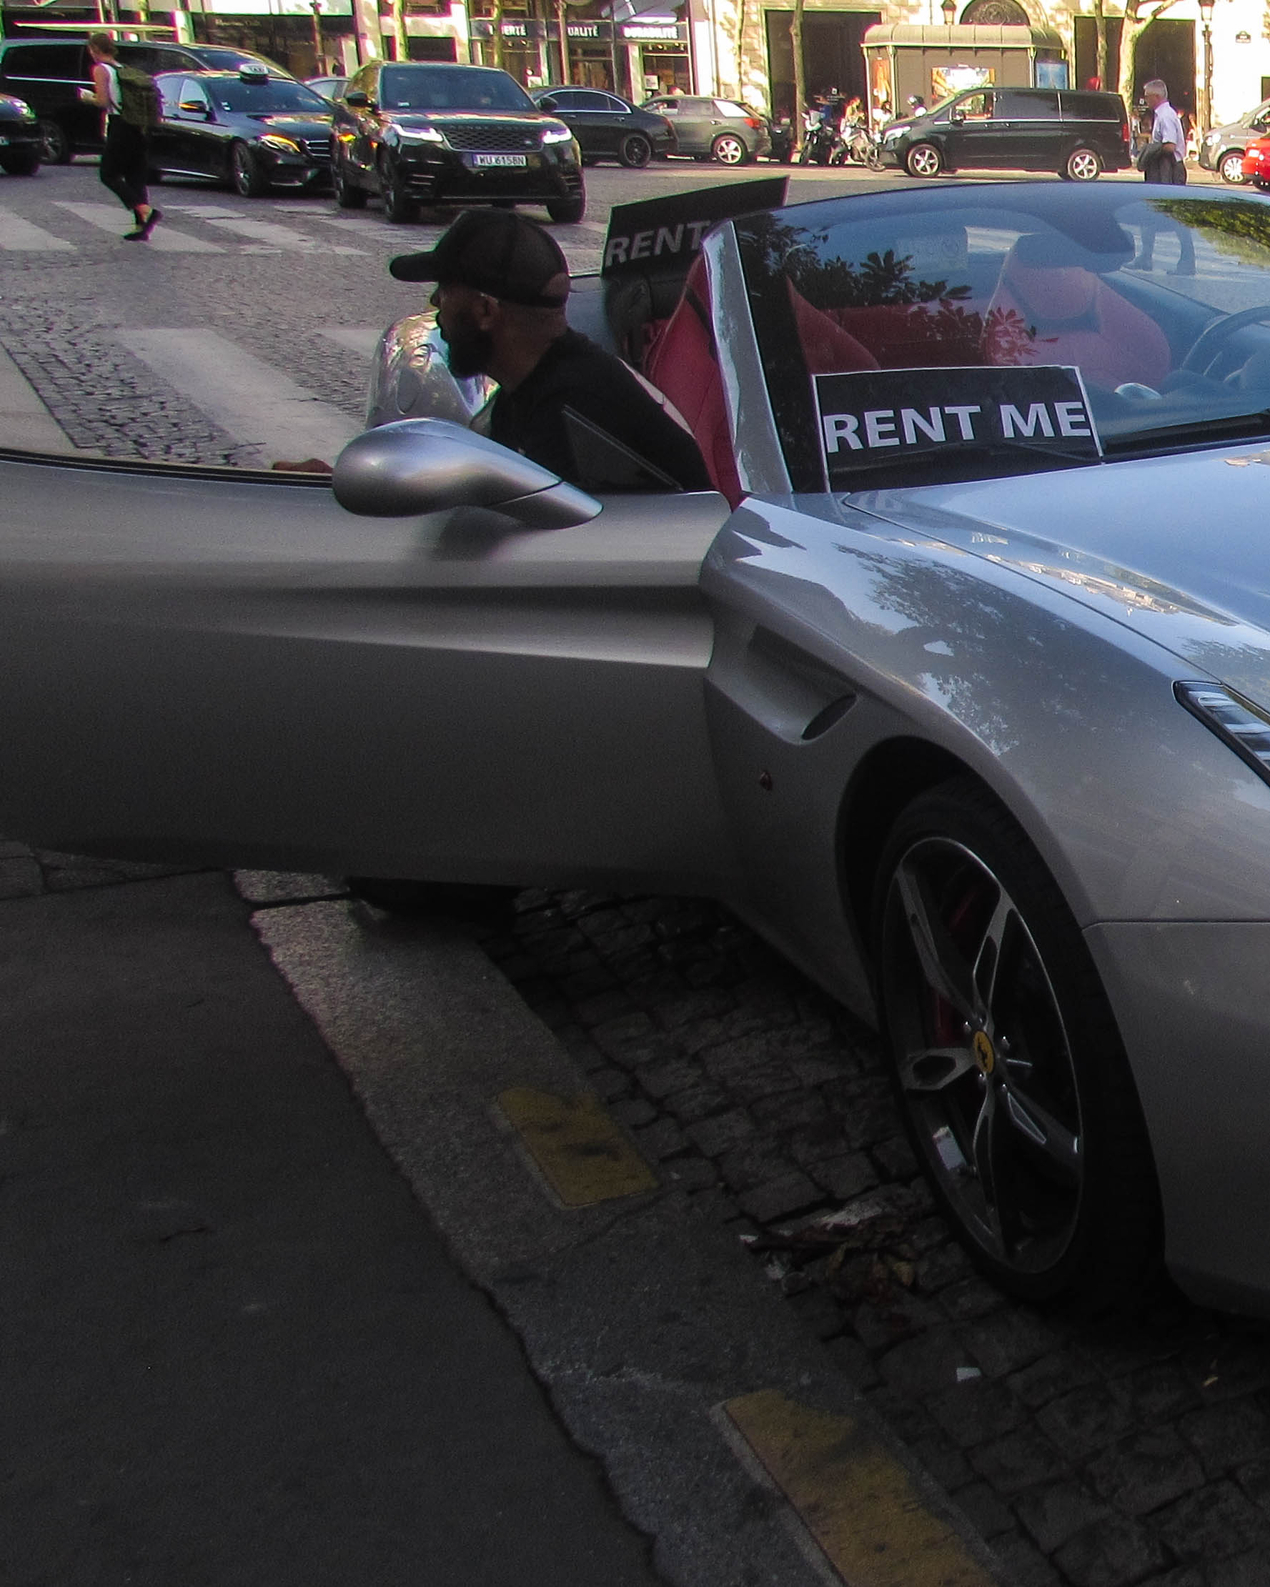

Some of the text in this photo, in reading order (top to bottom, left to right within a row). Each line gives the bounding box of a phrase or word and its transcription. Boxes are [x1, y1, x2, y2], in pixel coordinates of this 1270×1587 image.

[488, 24, 527, 36] LERTÉ
[566, 25, 599, 37] UALITÉ
[605, 220, 711, 268] RENT
[822, 401, 1092, 453] RENT ME
